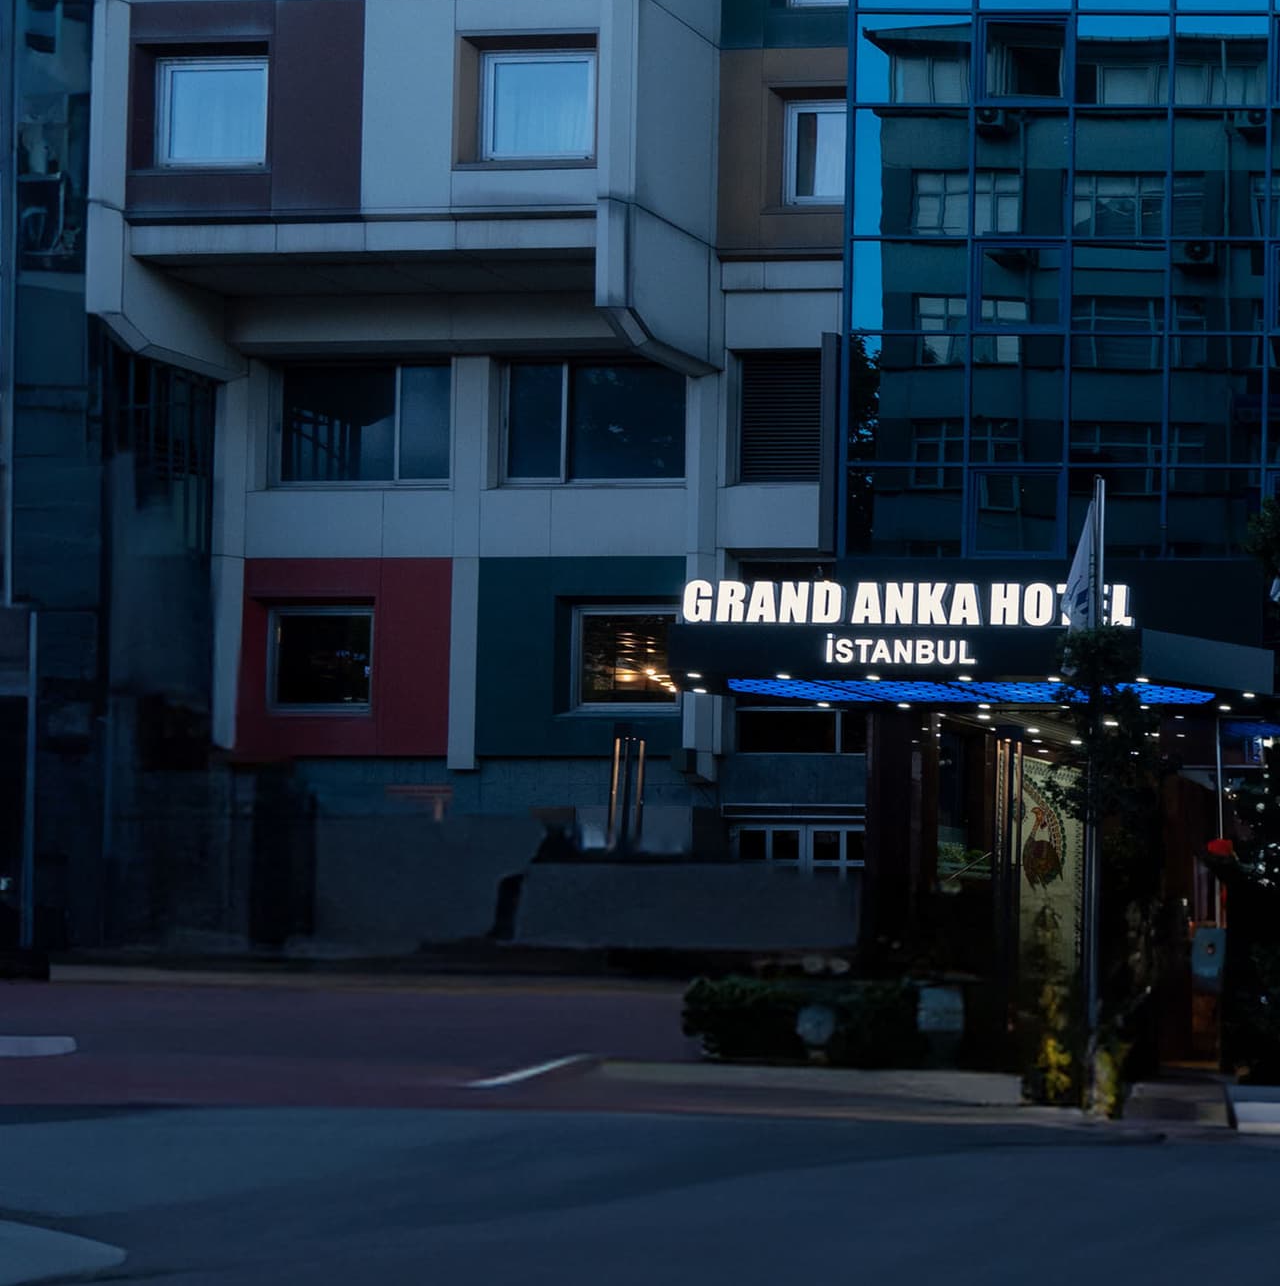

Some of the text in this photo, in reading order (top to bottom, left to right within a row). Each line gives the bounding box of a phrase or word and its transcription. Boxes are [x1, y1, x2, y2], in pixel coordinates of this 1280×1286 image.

[682, 579, 1132, 627] GRAND ANKA HOL
[825, 633, 976, 664] İSTANBUL
